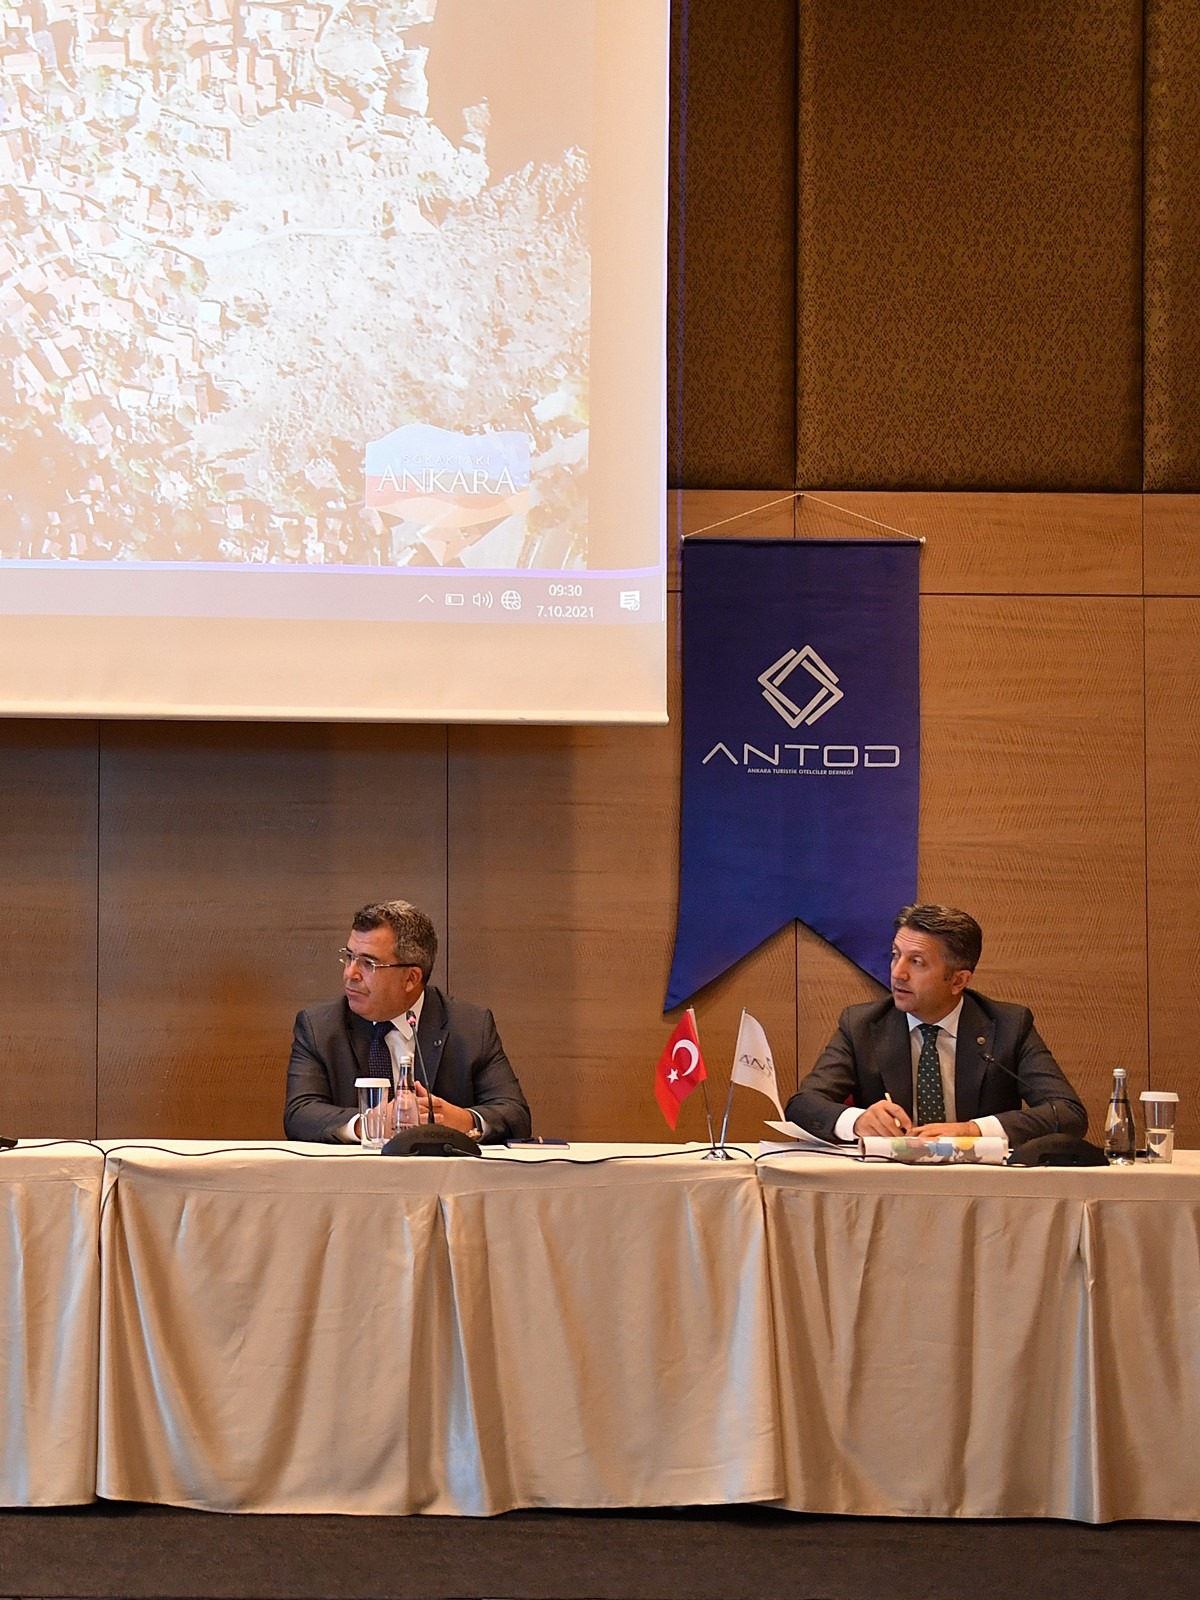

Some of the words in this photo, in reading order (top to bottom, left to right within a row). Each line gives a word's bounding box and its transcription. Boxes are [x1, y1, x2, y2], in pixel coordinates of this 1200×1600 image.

[376, 464, 520, 496] ANKARA
[548, 584, 583, 597] 09:30
[536, 605, 595, 618] 7.10.2021
[702, 741, 901, 768] ANTOD
